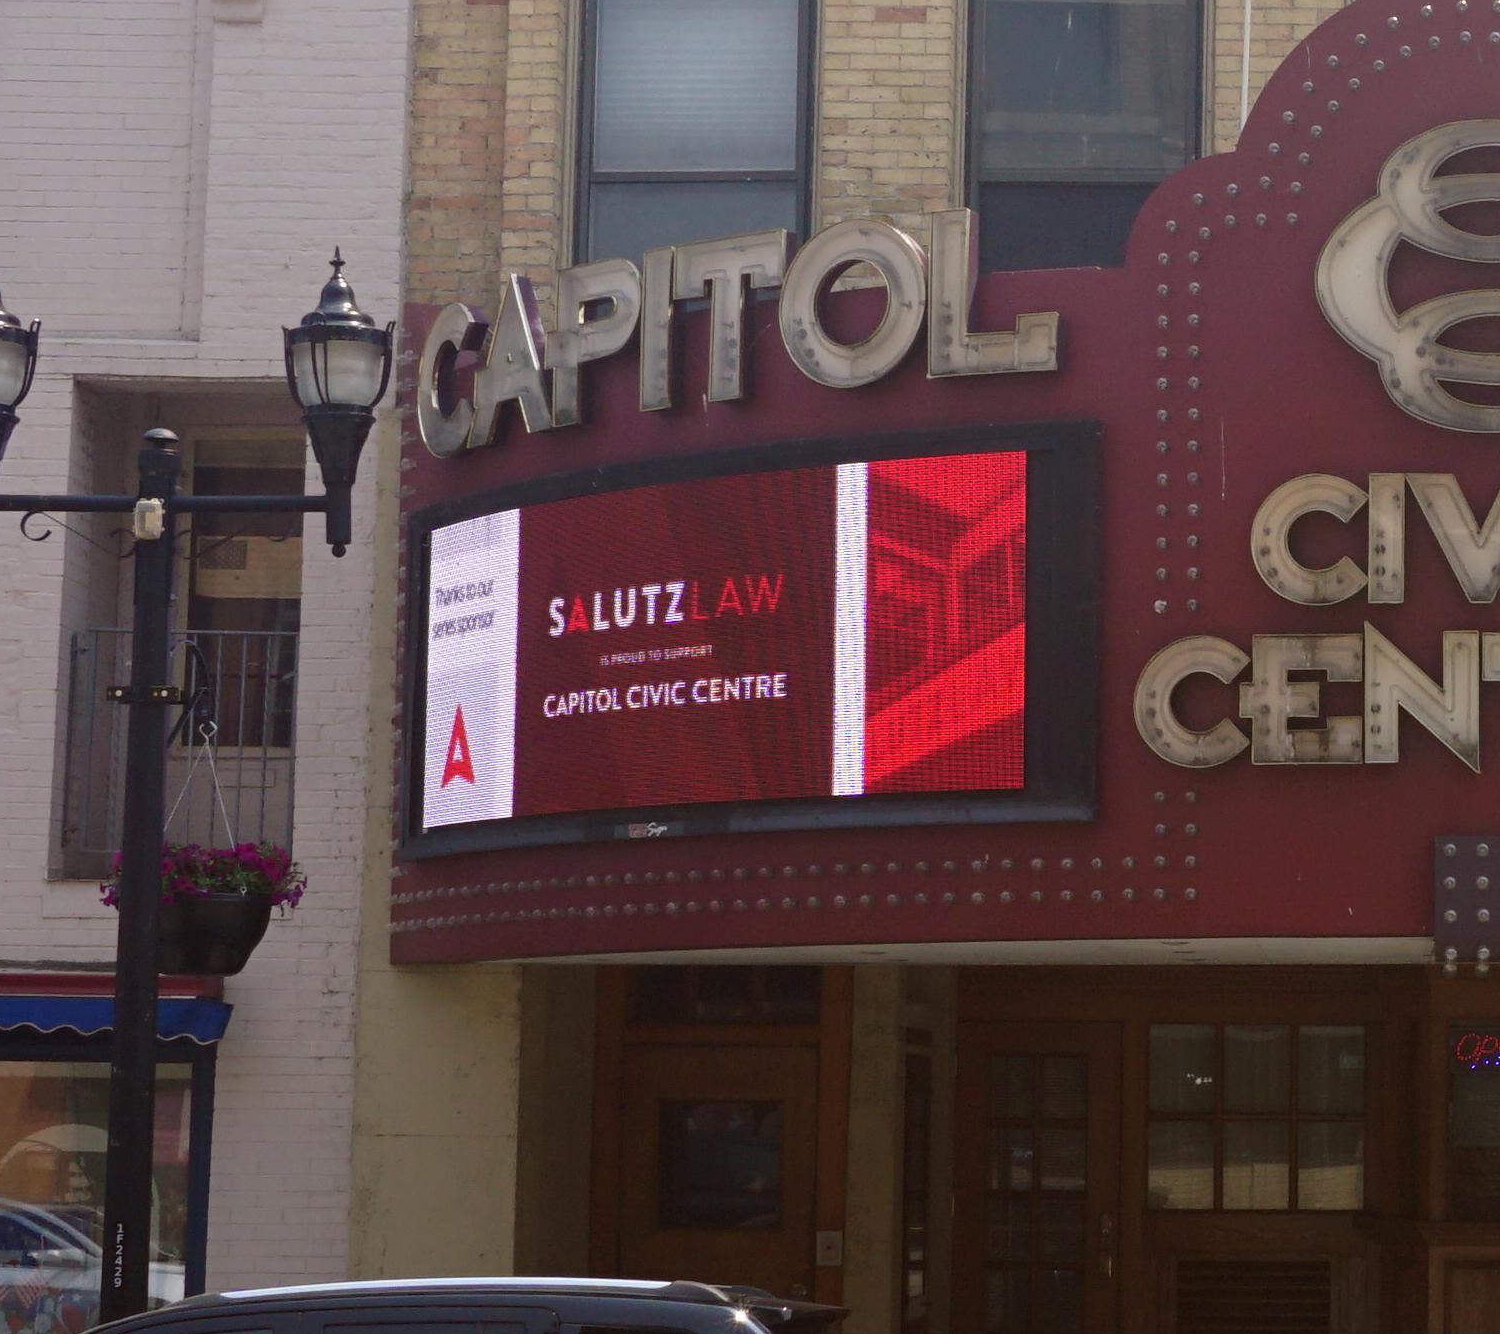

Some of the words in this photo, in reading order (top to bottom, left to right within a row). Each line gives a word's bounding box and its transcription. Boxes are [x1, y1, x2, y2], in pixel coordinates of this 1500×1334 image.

[417, 208, 1059, 458] CAPITOL
[543, 687, 623, 717] CAPITOL
[626, 681, 687, 710] CIVIC
[691, 672, 788, 704] CENTRE
[114, 1223, 125, 1288] 1F2429
